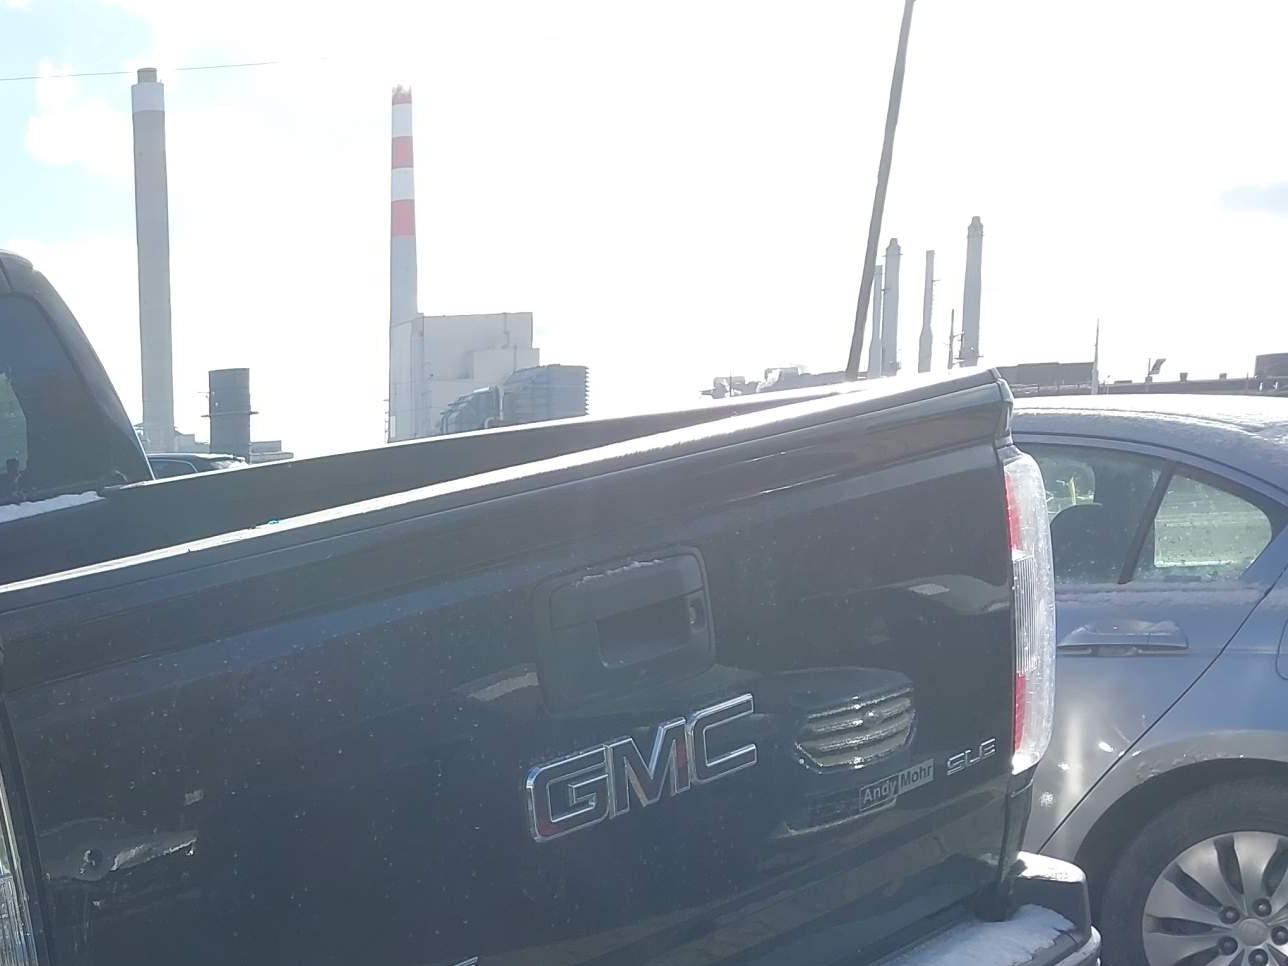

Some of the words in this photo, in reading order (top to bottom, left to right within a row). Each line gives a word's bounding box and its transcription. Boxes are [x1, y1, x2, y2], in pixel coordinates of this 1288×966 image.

[526, 693, 757, 842] GMC
[947, 738, 996, 775] SLE
[863, 779, 897, 803] Andy
[900, 764, 932, 787] Mohr
